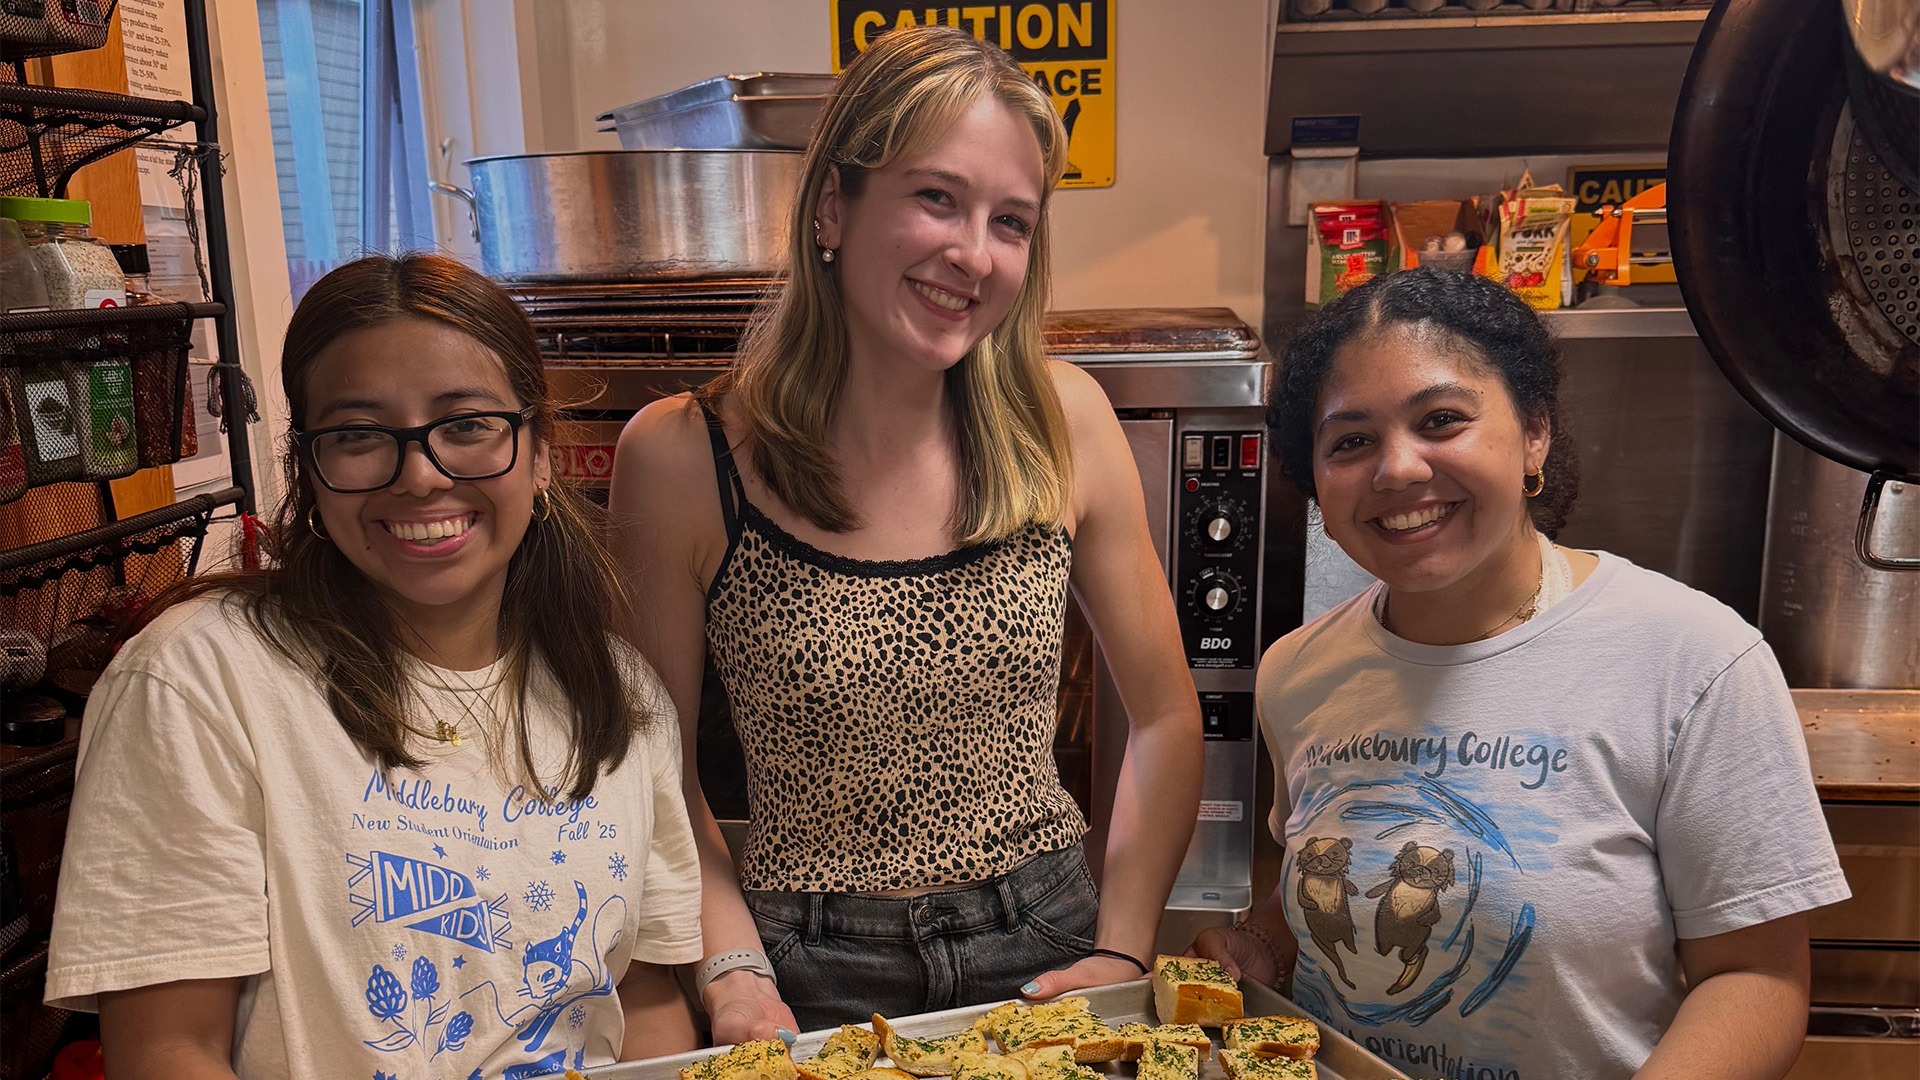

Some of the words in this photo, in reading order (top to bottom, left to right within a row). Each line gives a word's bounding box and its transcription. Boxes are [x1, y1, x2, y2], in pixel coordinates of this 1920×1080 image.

[1200, 637, 1232, 650] BDO
[1457, 731, 1568, 790] College
[363, 768, 489, 832] Middlebury
[350, 812, 391, 831] New
[396, 814, 450, 838] Student
[452, 825, 519, 851] Orientation
[557, 820, 590, 843] Fall
[597, 820, 617, 839] '25
[383, 860, 464, 916] MIDD
[440, 907, 487, 945] KIDS
